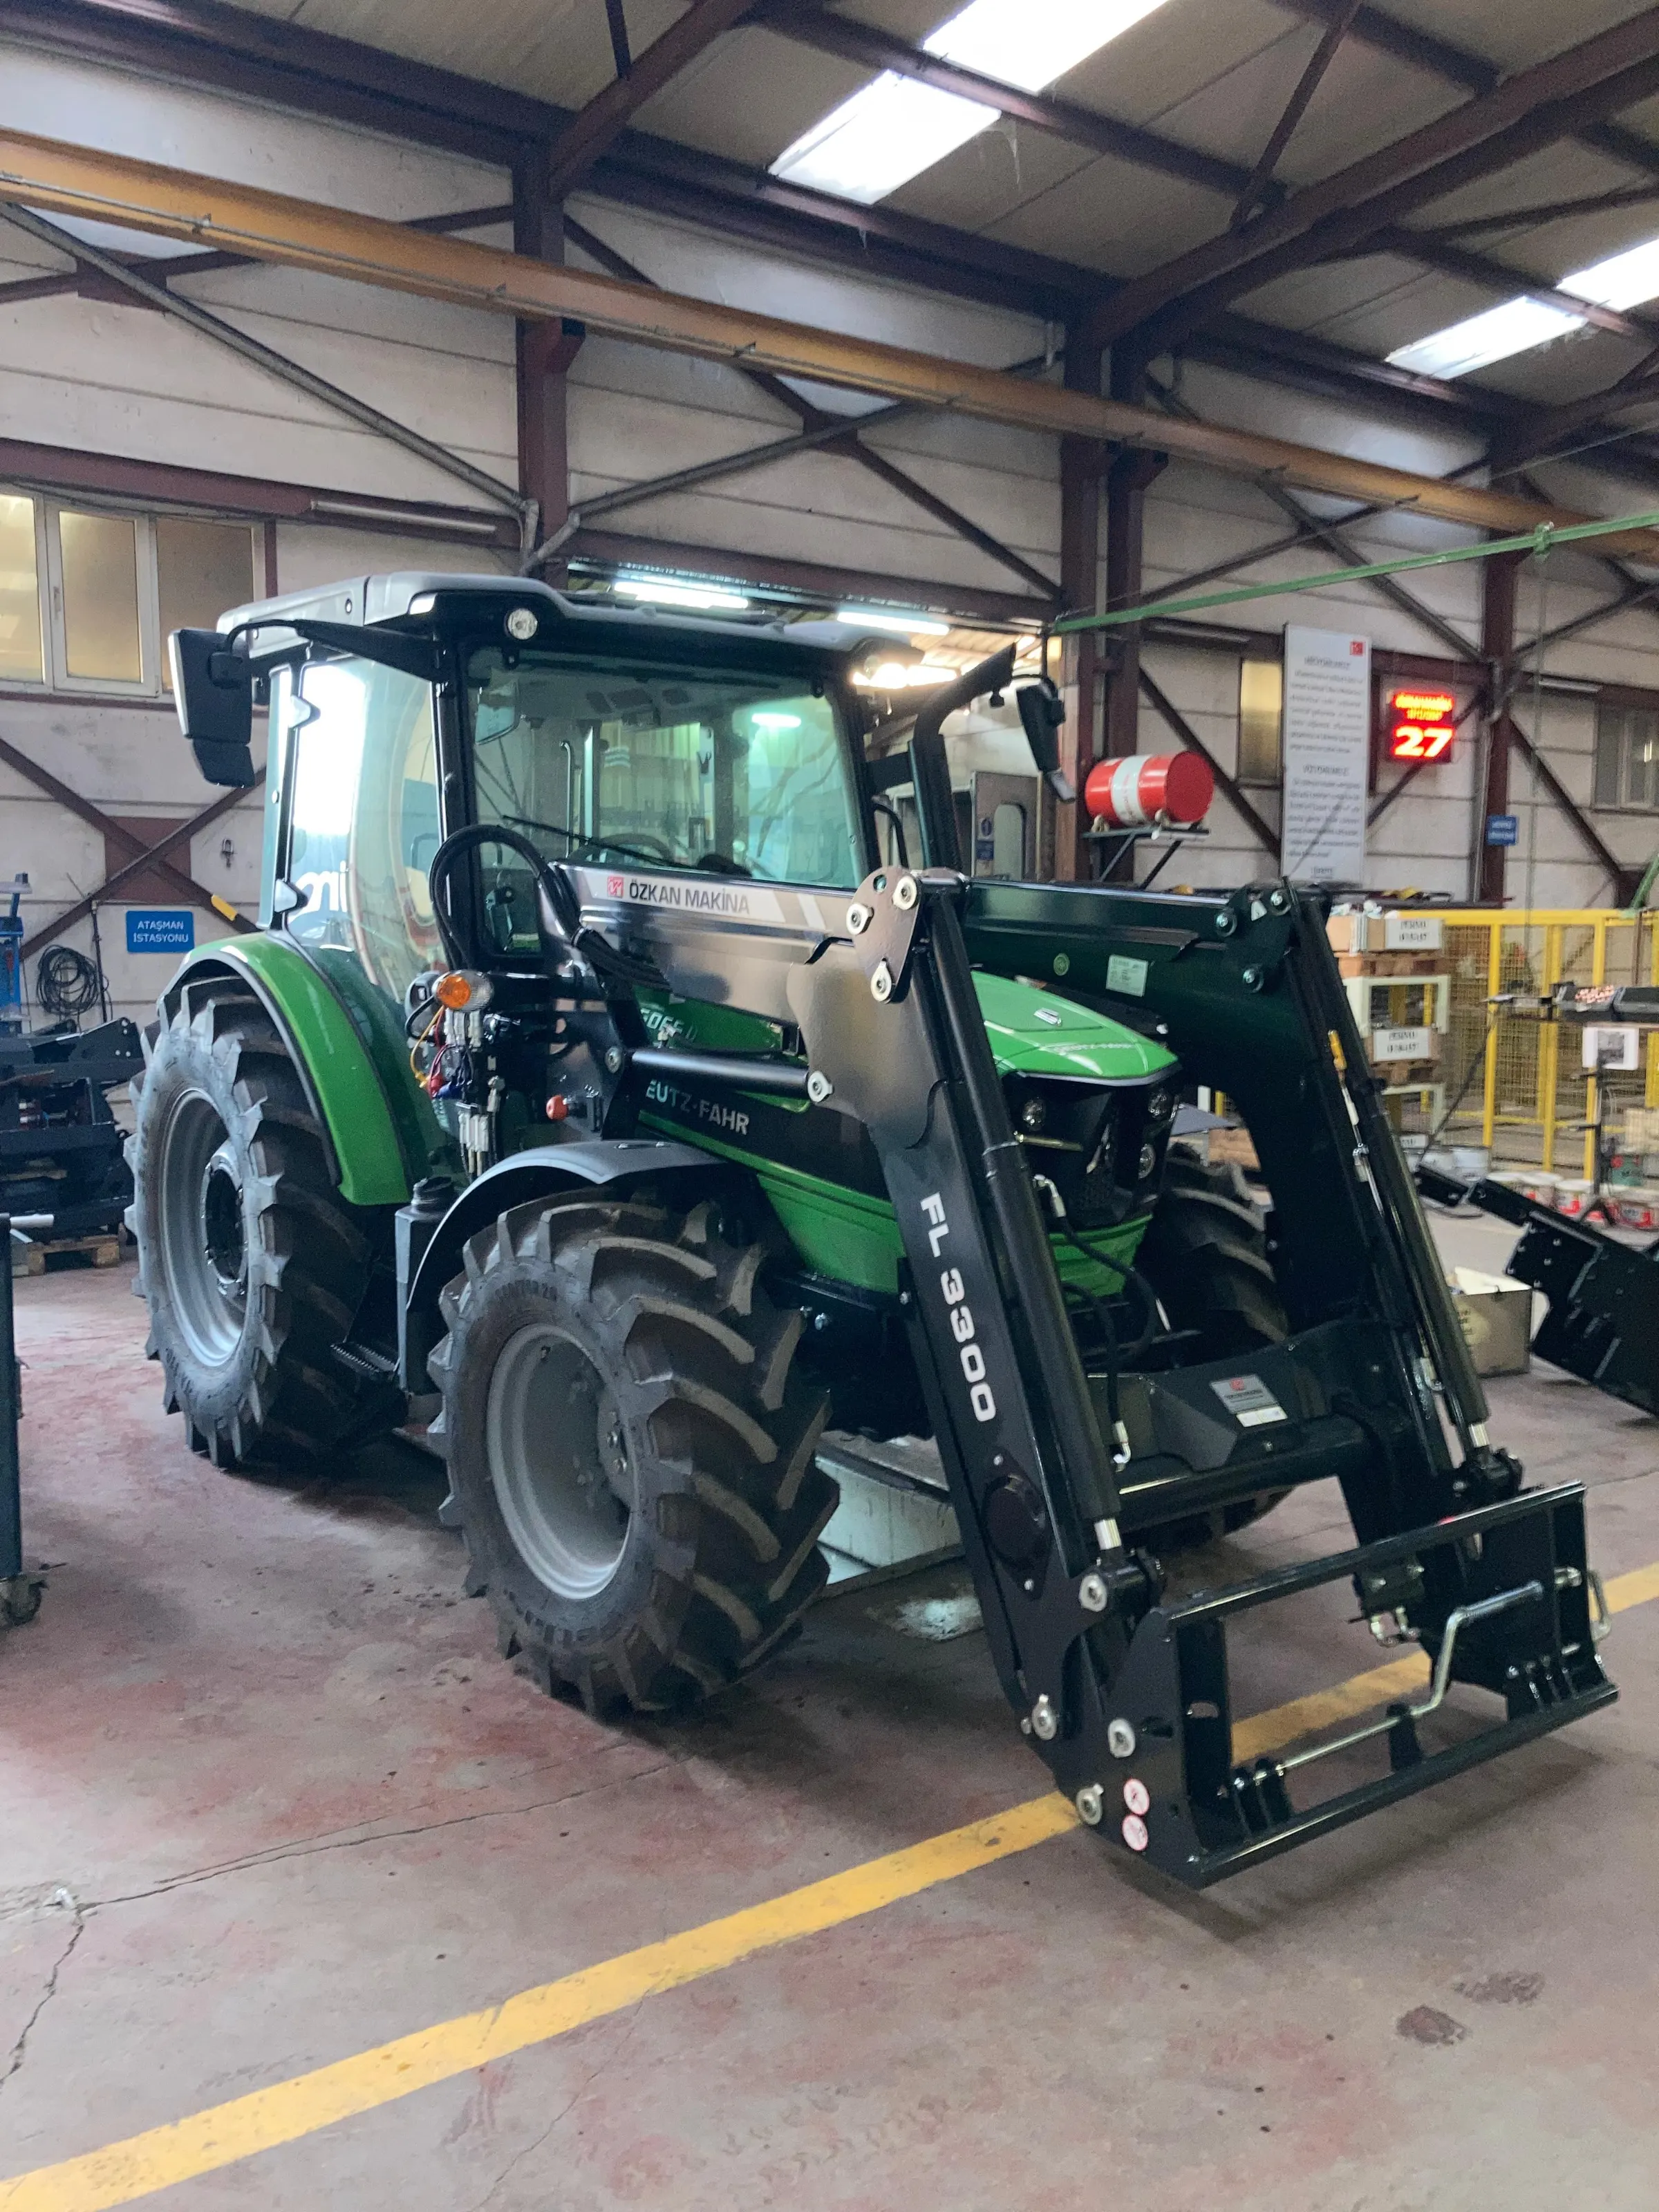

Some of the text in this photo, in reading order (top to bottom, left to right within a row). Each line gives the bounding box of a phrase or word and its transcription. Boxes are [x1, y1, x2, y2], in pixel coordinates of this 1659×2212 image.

[1395, 725, 1452, 757] 27
[630, 879, 750, 915] ÖZKAN MAKİNA
[133, 932, 189, 942] İSTASYONU
[137, 921, 184, 931] ATAŞMAN
[646, 1079, 750, 1136] EUTZ-FAHR
[920, 1192, 996, 1422] FL 3300
